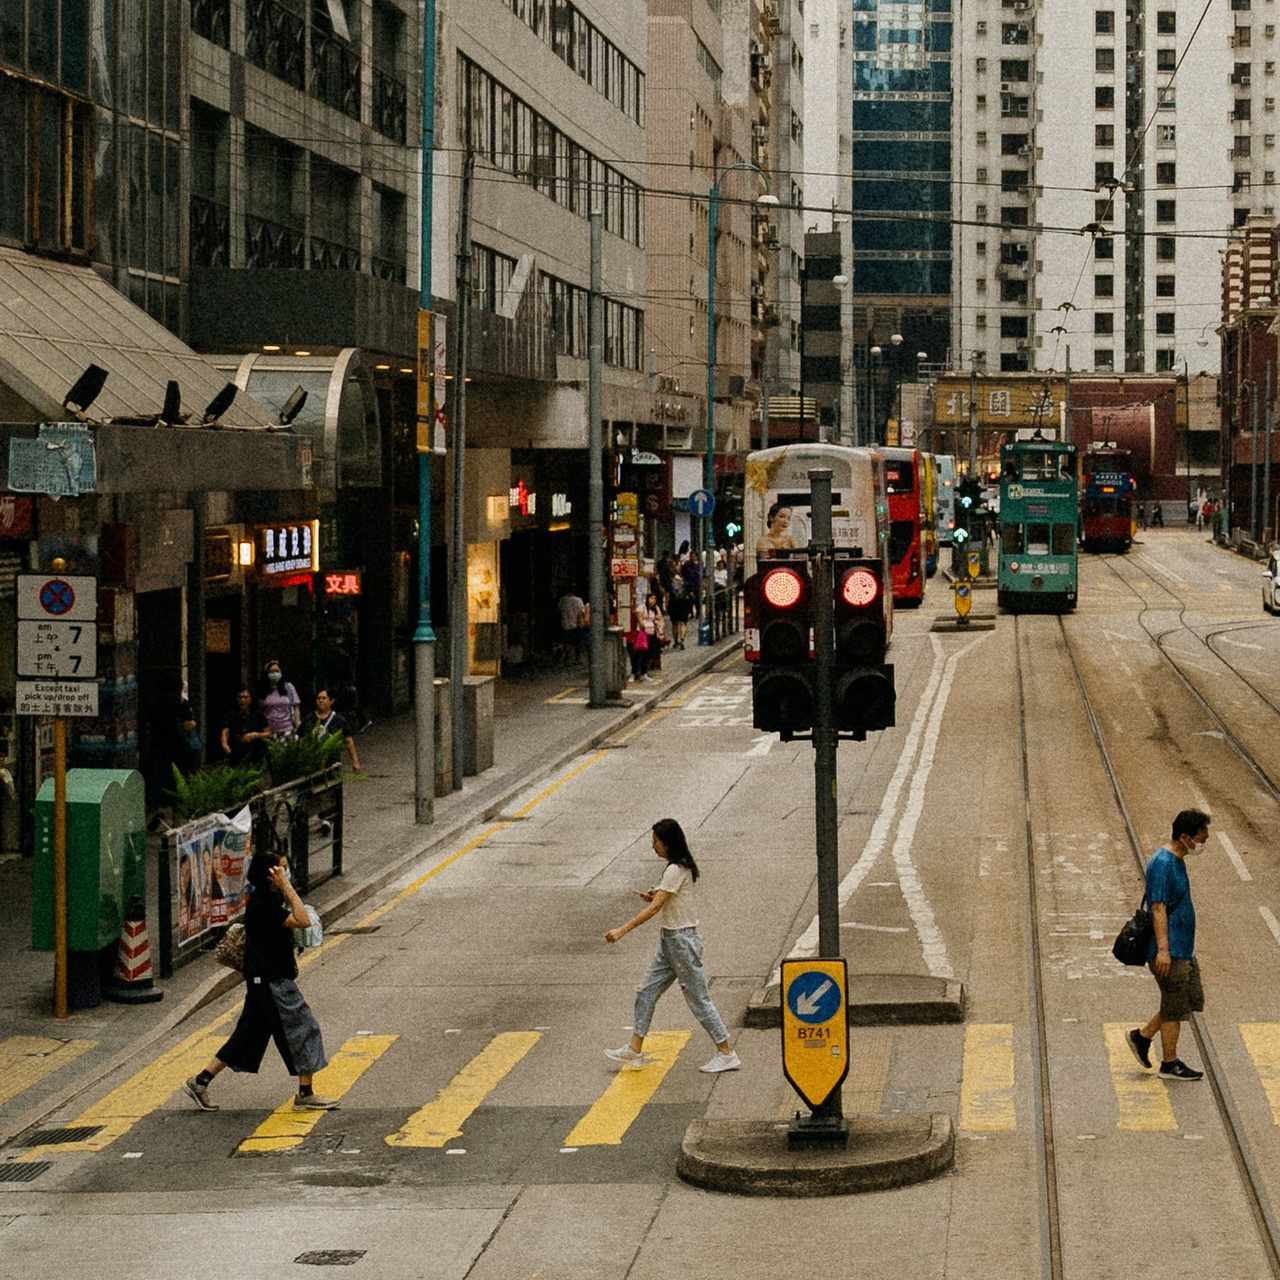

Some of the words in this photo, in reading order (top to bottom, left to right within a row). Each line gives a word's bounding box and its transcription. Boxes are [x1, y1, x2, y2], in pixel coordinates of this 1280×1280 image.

[326, 574, 360, 595] 文具
[69, 626, 82, 644] 7
[37, 653, 52, 661] pm
[69, 655, 82, 673] 7
[35, 684, 63, 693] Except
[25, 693, 42, 701] pick
[44, 693, 76, 702] up/drop
[78, 693, 90, 701] off
[797, 1027, 831, 1040] B741
